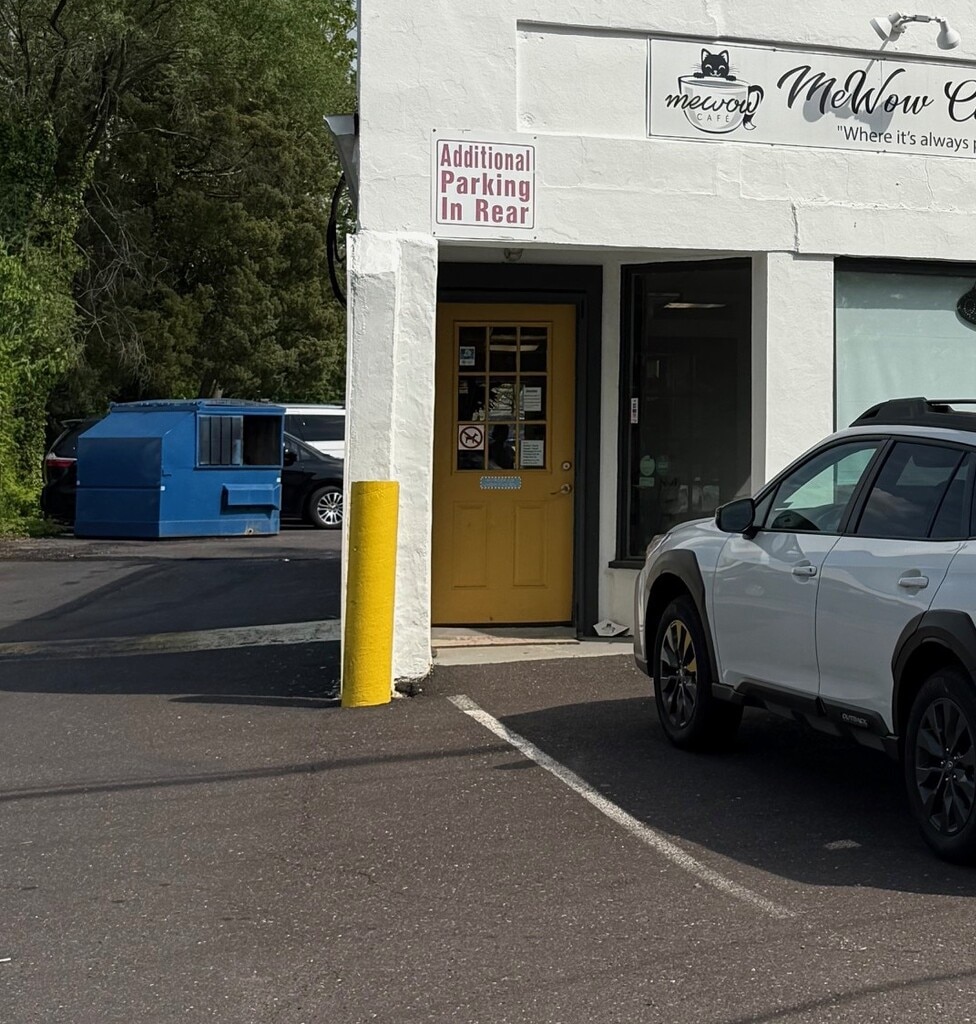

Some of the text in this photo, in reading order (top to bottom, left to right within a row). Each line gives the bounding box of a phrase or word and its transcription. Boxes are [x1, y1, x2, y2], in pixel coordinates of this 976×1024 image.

[665, 92, 760, 114] mewow
[776, 65, 935, 115] MeWow
[920, 131, 969, 152] always
[440, 143, 530, 172] Additional
[441, 170, 530, 202] Parking
[441, 196, 529, 224] In Rear
